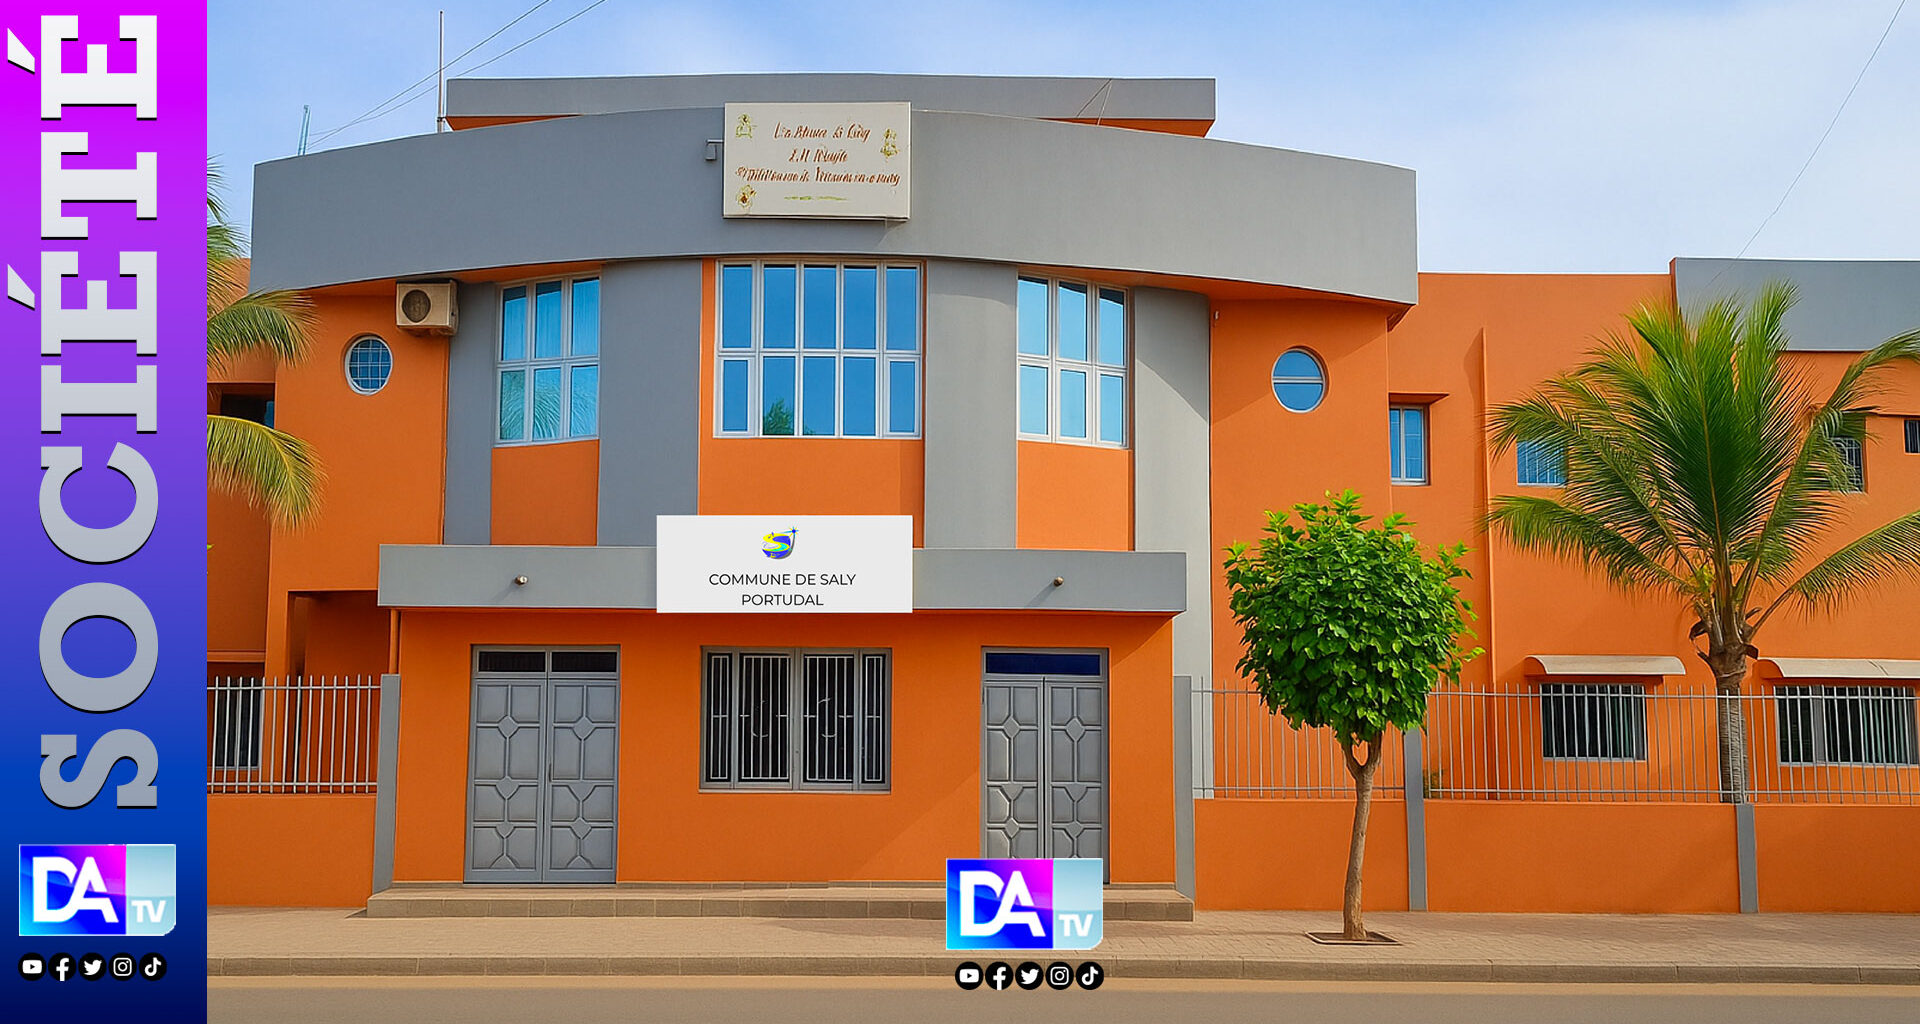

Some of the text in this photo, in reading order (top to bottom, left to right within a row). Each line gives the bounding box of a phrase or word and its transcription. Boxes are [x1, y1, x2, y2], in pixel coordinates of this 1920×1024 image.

[709, 573, 856, 586] COMMUNE DE SALY
[741, 594, 824, 606] PORTUDAL
